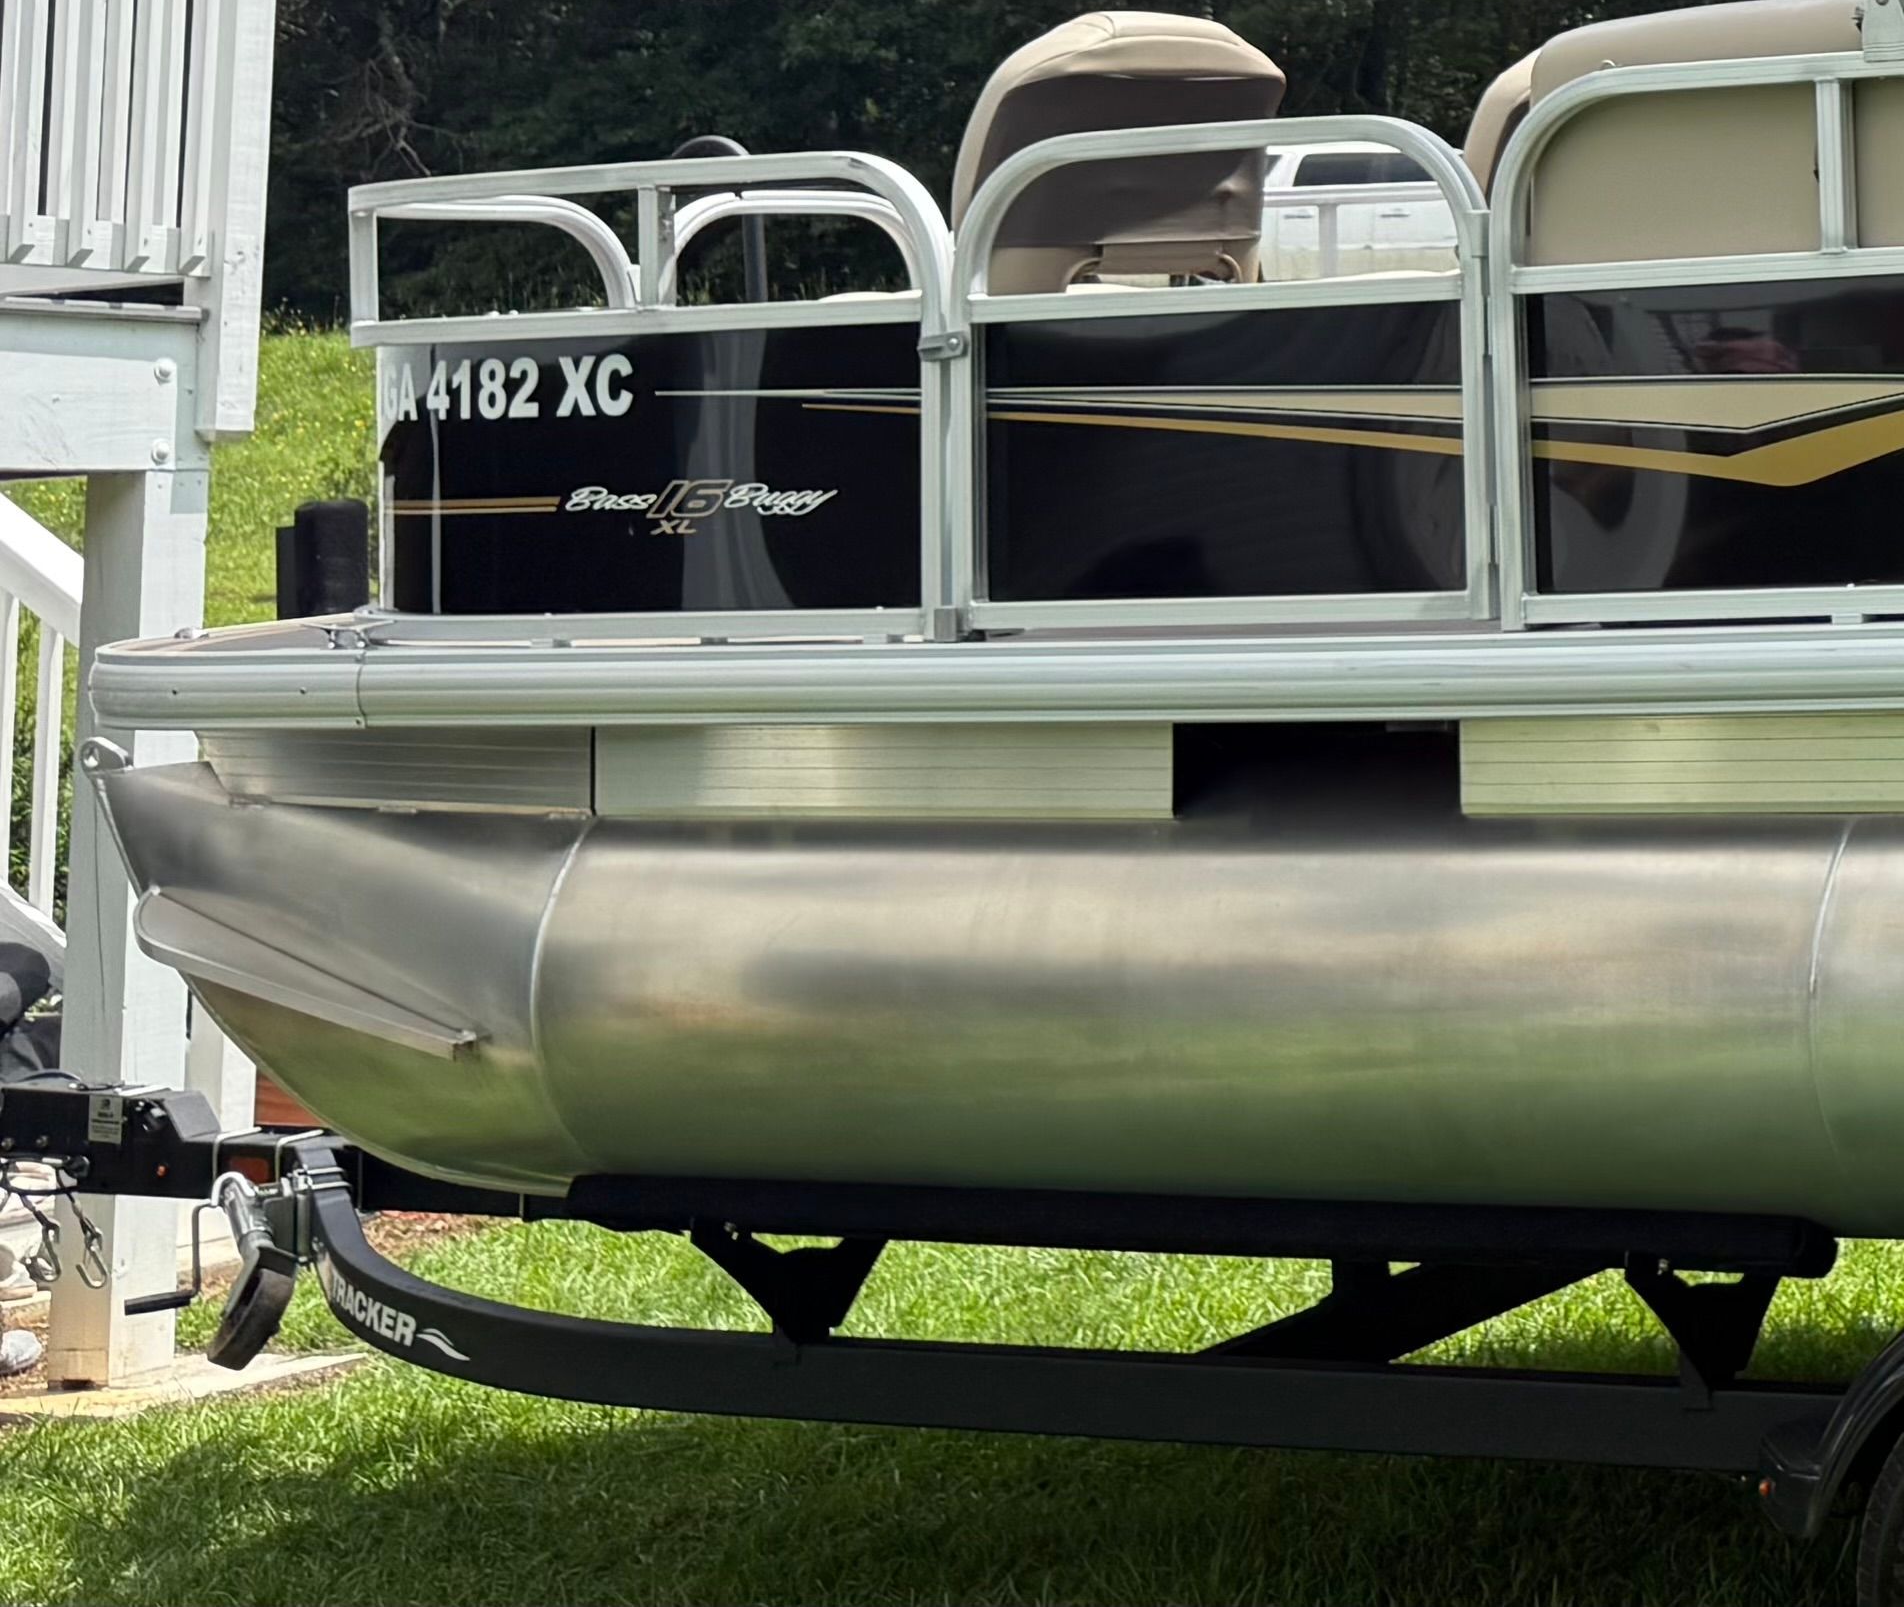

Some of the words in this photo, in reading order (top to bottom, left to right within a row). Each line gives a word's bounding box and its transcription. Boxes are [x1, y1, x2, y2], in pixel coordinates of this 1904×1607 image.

[383, 362, 419, 422] GA
[426, 356, 540, 421] 4182
[556, 353, 634, 418] XC
[565, 486, 657, 512] Bass
[646, 479, 733, 518] 16
[724, 482, 838, 516] Buggy
[650, 519, 697, 535] XL
[330, 1271, 416, 1346] TRACKER
